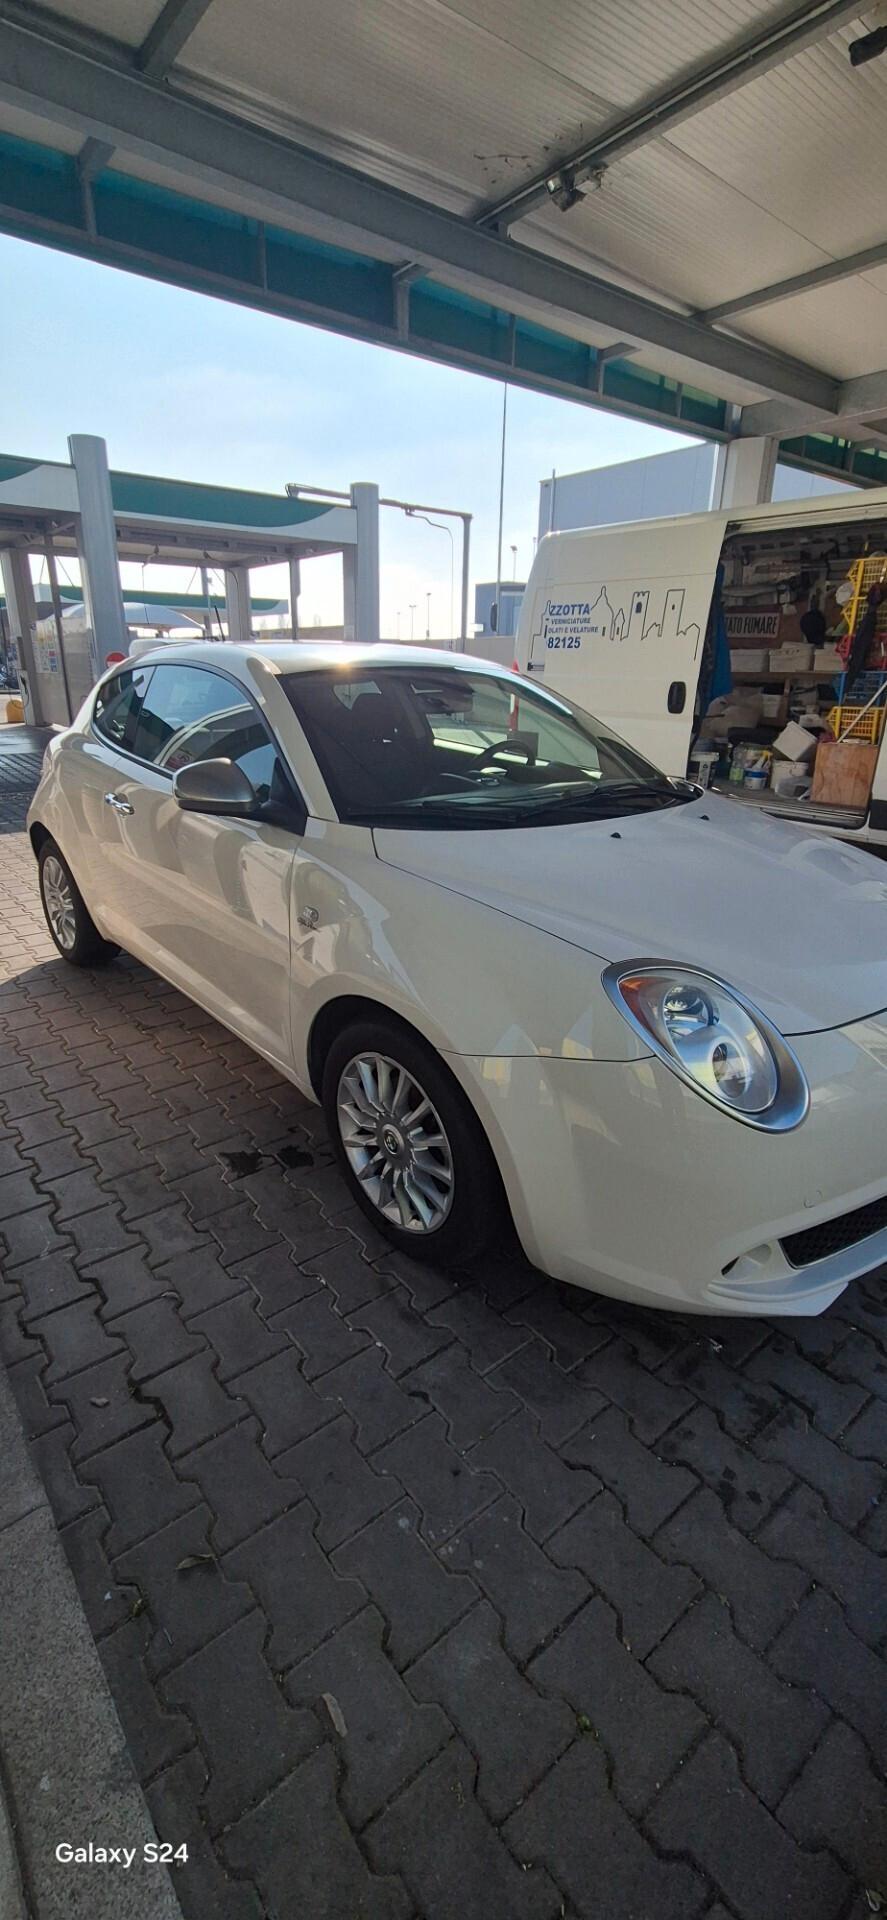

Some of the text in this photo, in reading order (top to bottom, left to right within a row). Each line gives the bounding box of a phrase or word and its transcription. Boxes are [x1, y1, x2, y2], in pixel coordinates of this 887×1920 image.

[551, 617, 591, 625] VERNICIATURE
[743, 616, 777, 634] FUMARE
[547, 636, 581, 649] 82125
